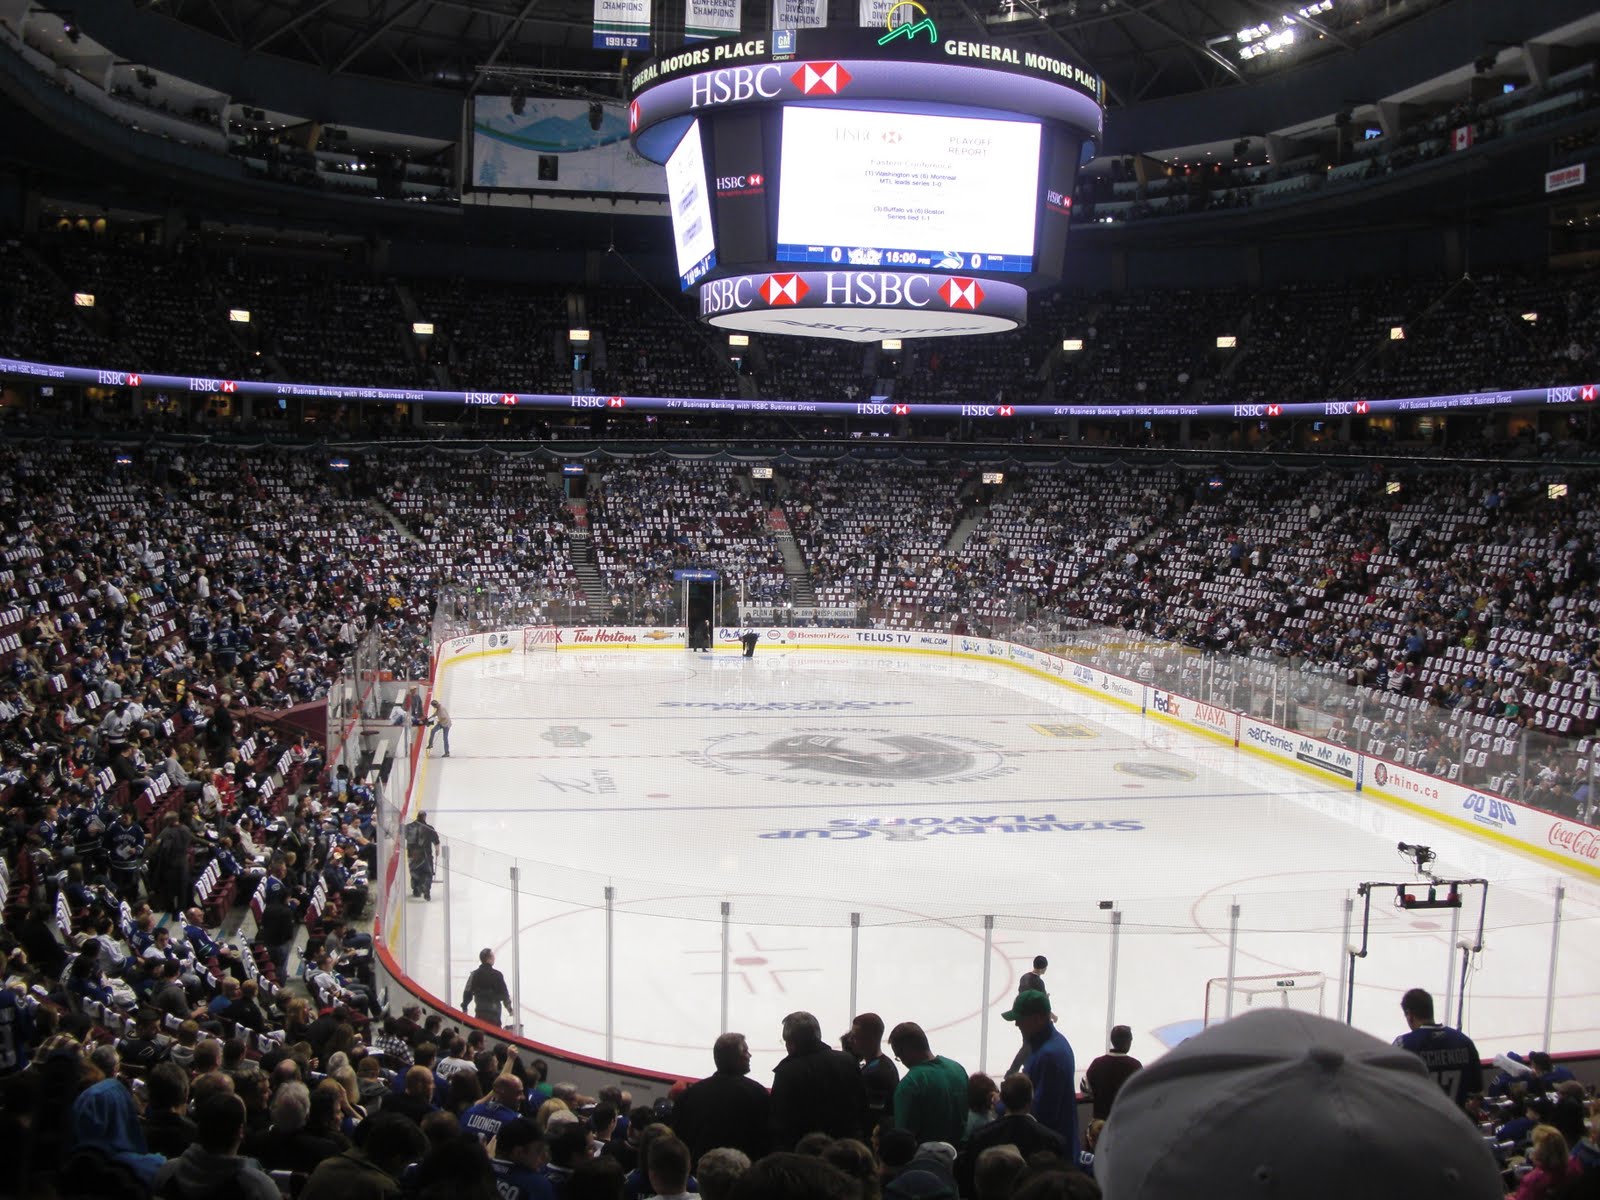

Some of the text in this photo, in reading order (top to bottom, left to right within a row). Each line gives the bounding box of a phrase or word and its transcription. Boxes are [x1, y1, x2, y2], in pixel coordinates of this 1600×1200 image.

[602, 2, 643, 12] CHAMPIONS
[693, 7, 734, 18] CHAMPIONS
[785, 5, 815, 14] DIVISION
[780, 12, 820, 24] CHAMPIONS
[872, 11, 901, 21] DIVISON
[606, 37, 638, 47] 1991.92
[778, 36, 791, 46] GM
[632, 40, 765, 92] GENERAL MOTORS PLACE
[944, 40, 1096, 92] GENERAL MOTORS PLACE
[690, 64, 782, 108] HSBC
[950, 136, 992, 146] PLAYOFF
[948, 147, 987, 157] REPORT
[870, 159, 903, 167] Eastern
[875, 170, 910, 179] Washington
[716, 176, 746, 190] HSBC
[1047, 190, 1063, 206] HSBC
[831, 247, 842, 262] 0
[885, 251, 917, 264] 15:00
[970, 254, 982, 269] 0
[823, 271, 931, 307] HSBC
[703, 276, 753, 315] HSBC
[31, 366, 48, 376] Business
[49, 368, 65, 378] Direct
[98, 370, 125, 386] HSBC
[190, 378, 220, 392] HSBC
[277, 386, 291, 394] 24/7
[293, 387, 318, 396] Business
[320, 388, 342, 398] Banking
[360, 390, 377, 398] HSBC
[378, 391, 404, 399] Business
[406, 392, 424, 400] Direct
[465, 393, 498, 405] HSBC
[1546, 386, 1578, 403] HSBC
[571, 396, 605, 408] HSBC
[666, 400, 680, 408] 24/7
[683, 401, 709, 409] Business
[711, 401, 735, 410] Banking
[751, 402, 768, 410] HSBC
[770, 403, 796, 411] Business
[857, 404, 890, 415] HSBC
[962, 405, 995, 417] HSBC
[1054, 407, 1198, 416] 24/7 Business Banking with HSBC Business Direct
[1234, 404, 1263, 417] HSBC
[1325, 402, 1352, 415] HSBC
[752, 609, 768, 617] PLAN
[574, 628, 637, 642] Tim Hortons
[719, 628, 731, 639] On
[856, 632, 912, 644] TELUS TV
[920, 636, 948, 646] NHL.COM
[1154, 690, 1181, 717] FedEx
[1195, 703, 1226, 728] AVAYA
[1255, 727, 1293, 753] BCFerries
[1389, 774, 1440, 800] rhino.ca
[1463, 794, 1486, 813] GO
[1488, 799, 1517, 826] BIG
[827, 814, 1056, 826] PLAYOFFS
[758, 820, 1145, 840] STANLEY CUP
[467, 1113, 502, 1134] LUONGO
